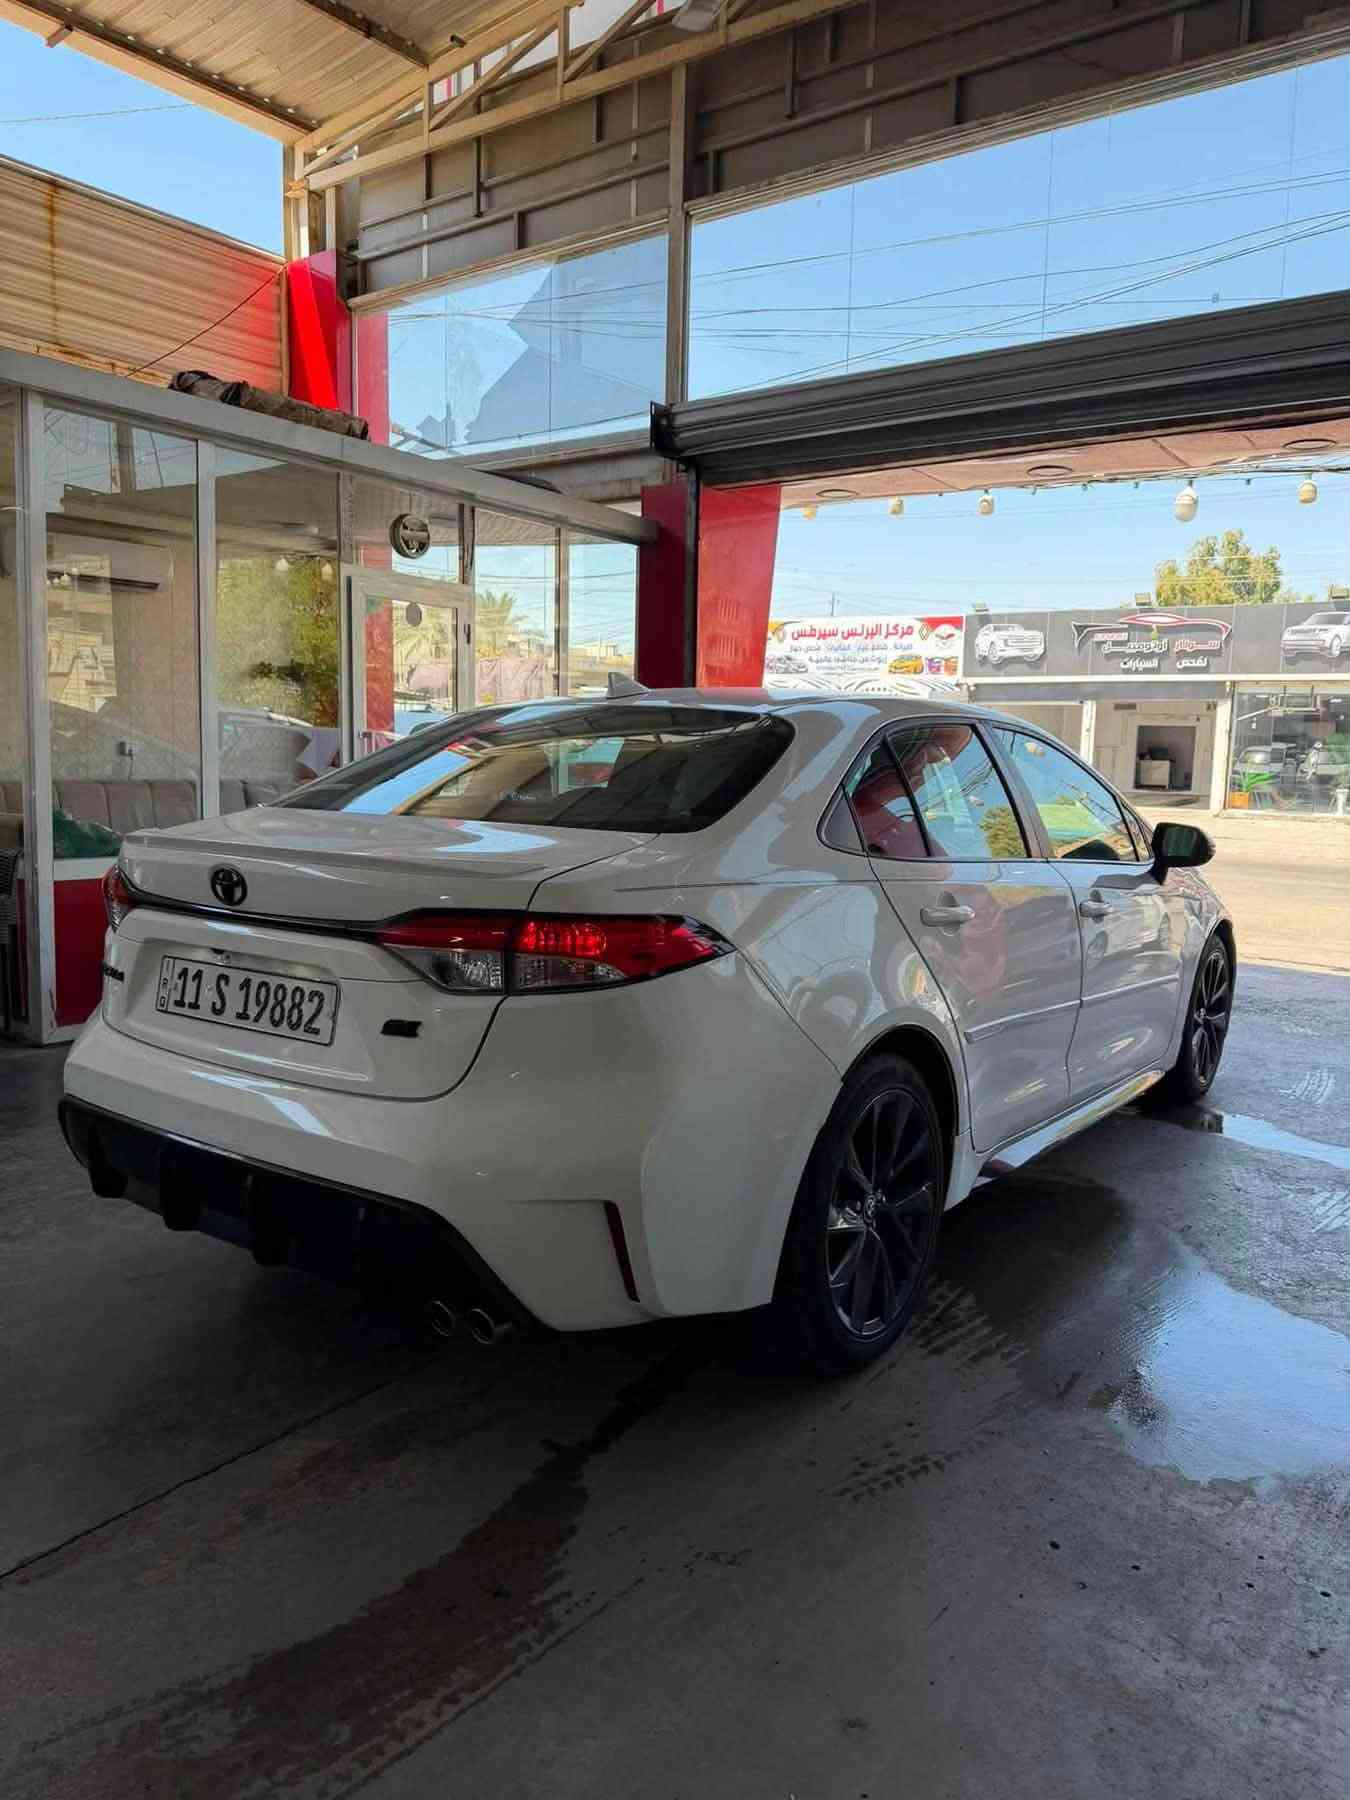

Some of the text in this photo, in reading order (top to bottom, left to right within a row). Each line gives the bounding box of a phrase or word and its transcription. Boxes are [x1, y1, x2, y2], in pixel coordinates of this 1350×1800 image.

[884, 624, 914, 640] مركز
[1120, 656, 1208, 671] لفحص السيارات
[174, 967, 325, 1035] 11 S 19882
